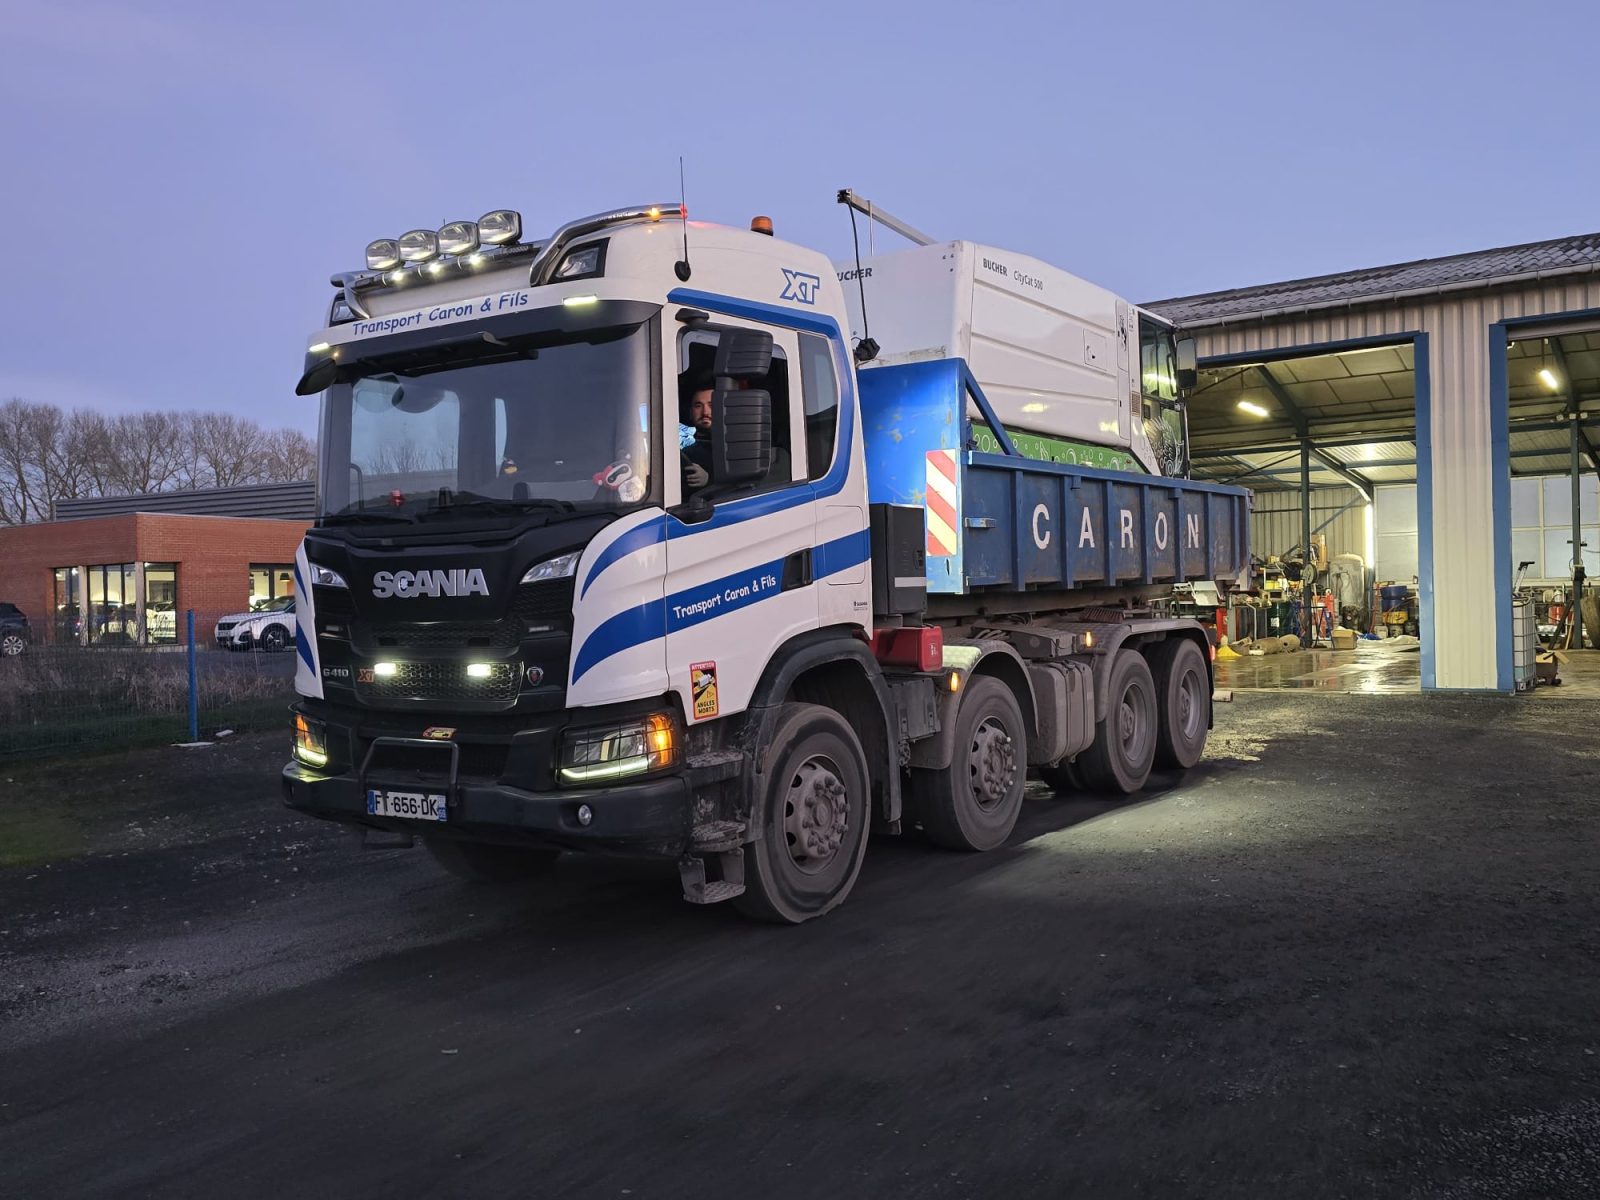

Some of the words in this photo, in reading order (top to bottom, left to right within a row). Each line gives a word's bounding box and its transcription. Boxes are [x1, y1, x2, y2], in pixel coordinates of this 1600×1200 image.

[779, 267, 820, 305] XT
[837, 267, 873, 282] UCHER
[983, 258, 1008, 277] BUCHER
[1013, 270, 1033, 287] CityCat
[1034, 278, 1043, 291] 500
[353, 312, 422, 336] Transport
[429, 303, 473, 321] Caron
[480, 297, 491, 312] &
[498, 291, 528, 310] Fils
[1032, 503, 1200, 550] CARON
[372, 568, 490, 598] SCANIA
[673, 593, 721, 619] Transport
[724, 585, 750, 602] Caron
[752, 580, 760, 592] &
[760, 575, 777, 590] Fils
